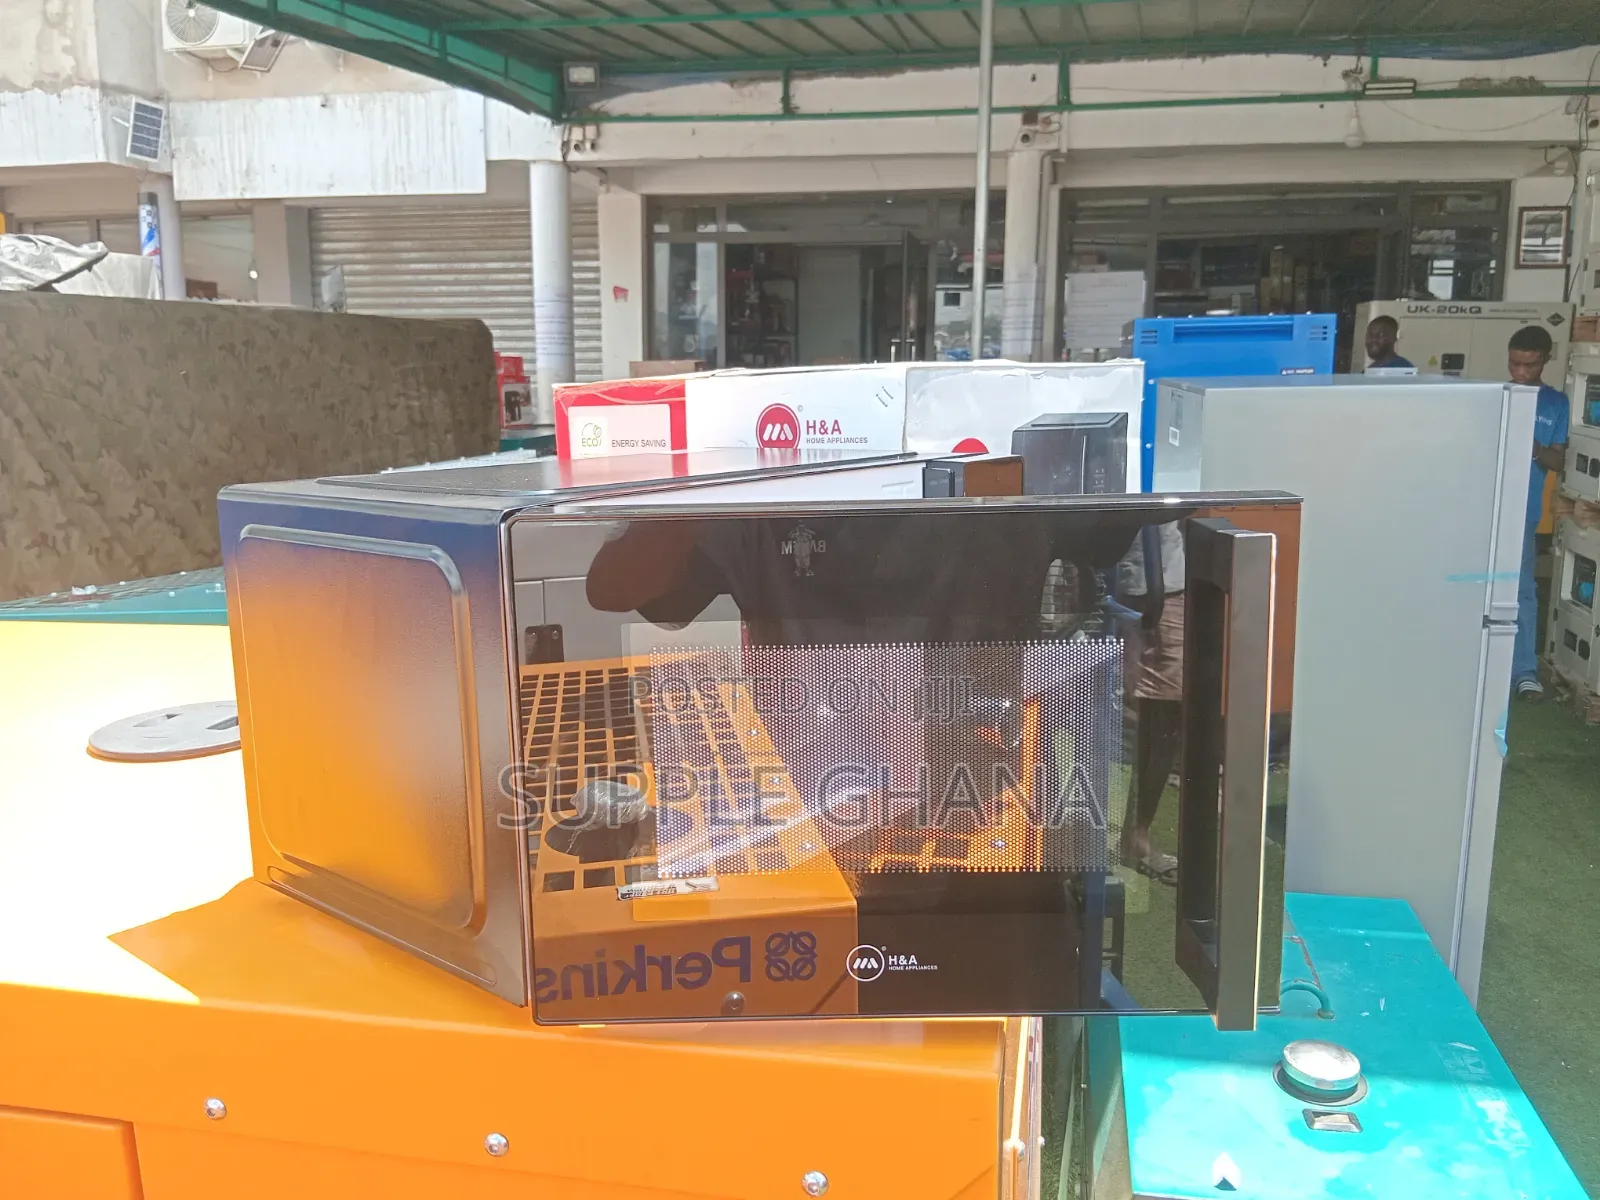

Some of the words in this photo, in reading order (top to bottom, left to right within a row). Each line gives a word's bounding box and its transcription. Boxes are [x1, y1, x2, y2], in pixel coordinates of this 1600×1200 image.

[806, 420, 842, 435] H&A
[581, 438, 599, 447] ECO
[611, 439, 640, 448] ENERGY
[640, 439, 667, 448] SAVING
[827, 436, 868, 444] APPLIANCES
[888, 955, 918, 965] H&A
